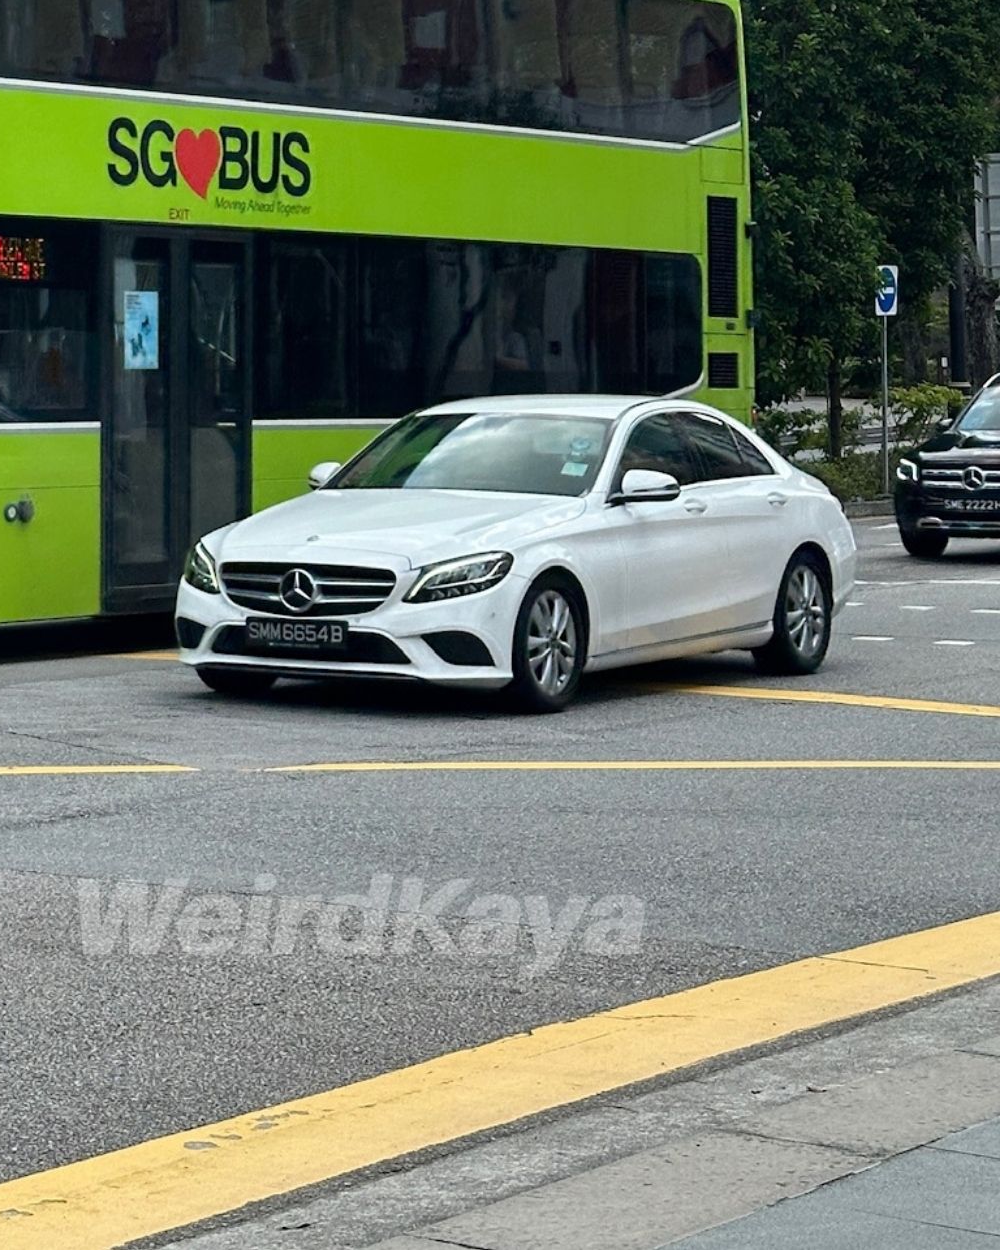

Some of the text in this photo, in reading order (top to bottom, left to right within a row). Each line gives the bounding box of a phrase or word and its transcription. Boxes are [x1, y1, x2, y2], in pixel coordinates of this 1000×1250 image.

[107, 117, 311, 197] SG BUS
[169, 208, 190, 220] EXIT
[215, 196, 311, 217] Moving Ahead Together
[248, 621, 343, 643] SMM6654B
